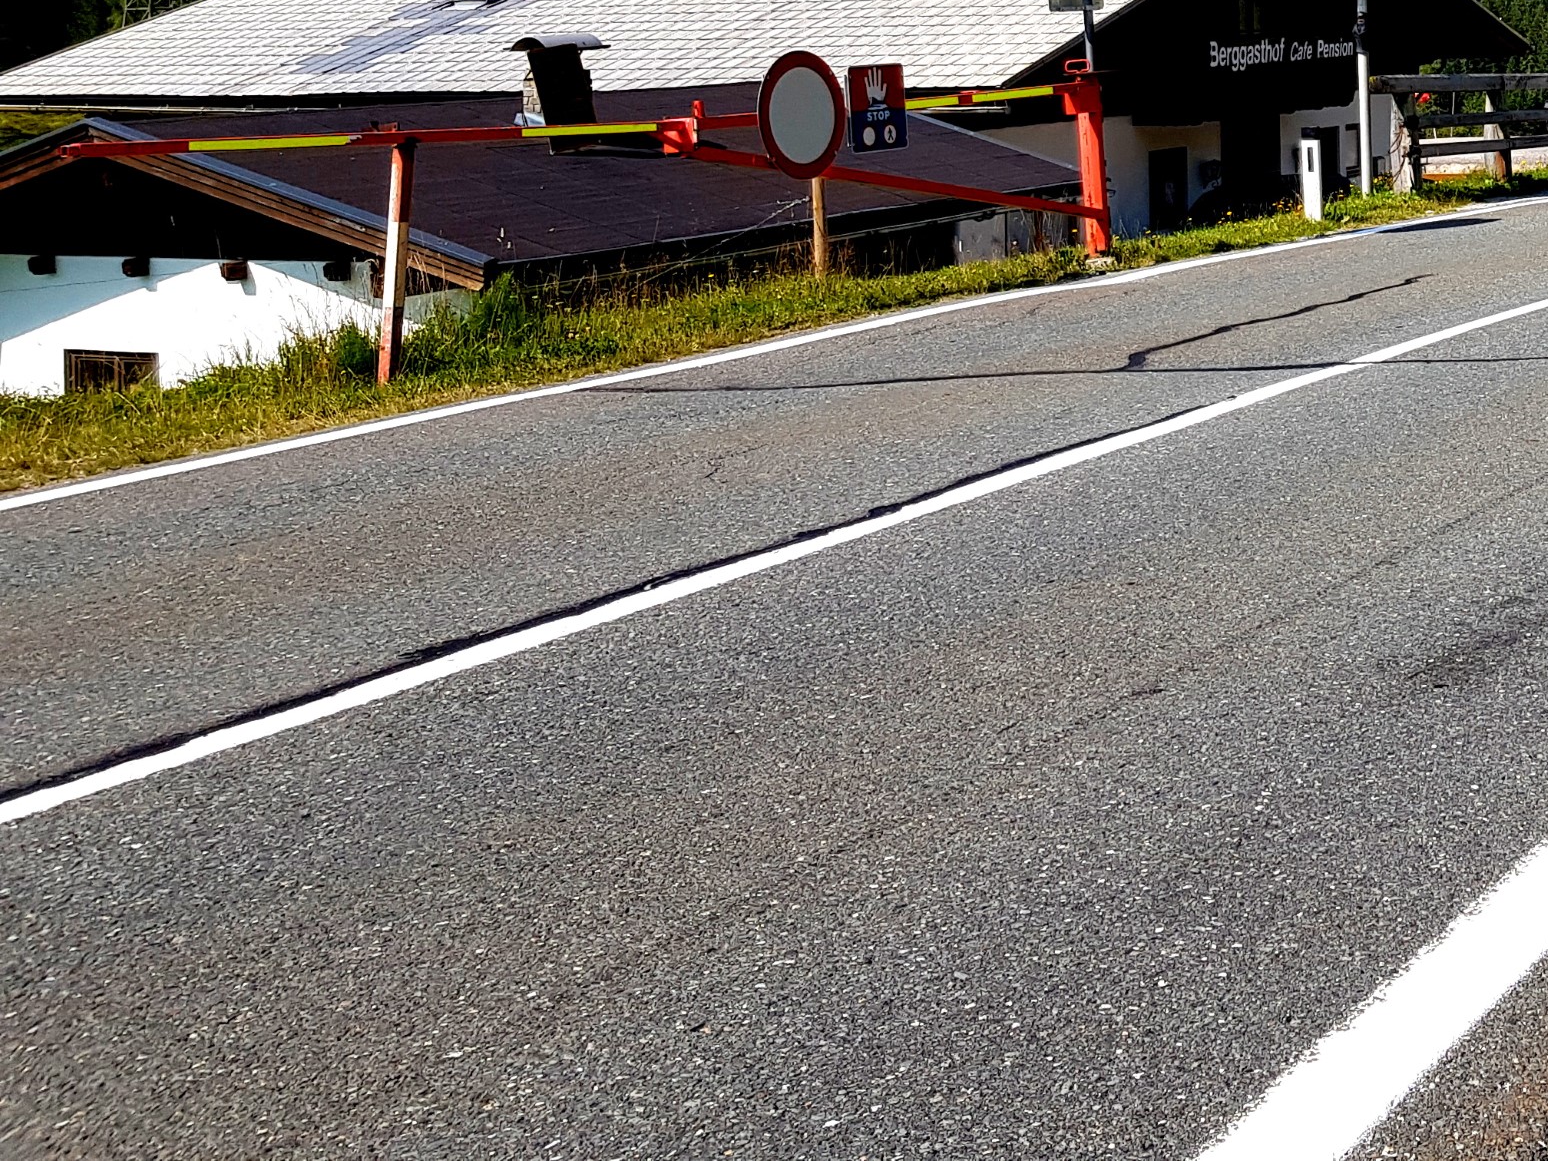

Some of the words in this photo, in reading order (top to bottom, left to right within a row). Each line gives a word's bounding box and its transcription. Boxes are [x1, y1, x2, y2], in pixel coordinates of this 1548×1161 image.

[1209, 37, 1285, 72] Berggasthof
[1317, 38, 1354, 59] Pension
[866, 110, 891, 122] STOP
